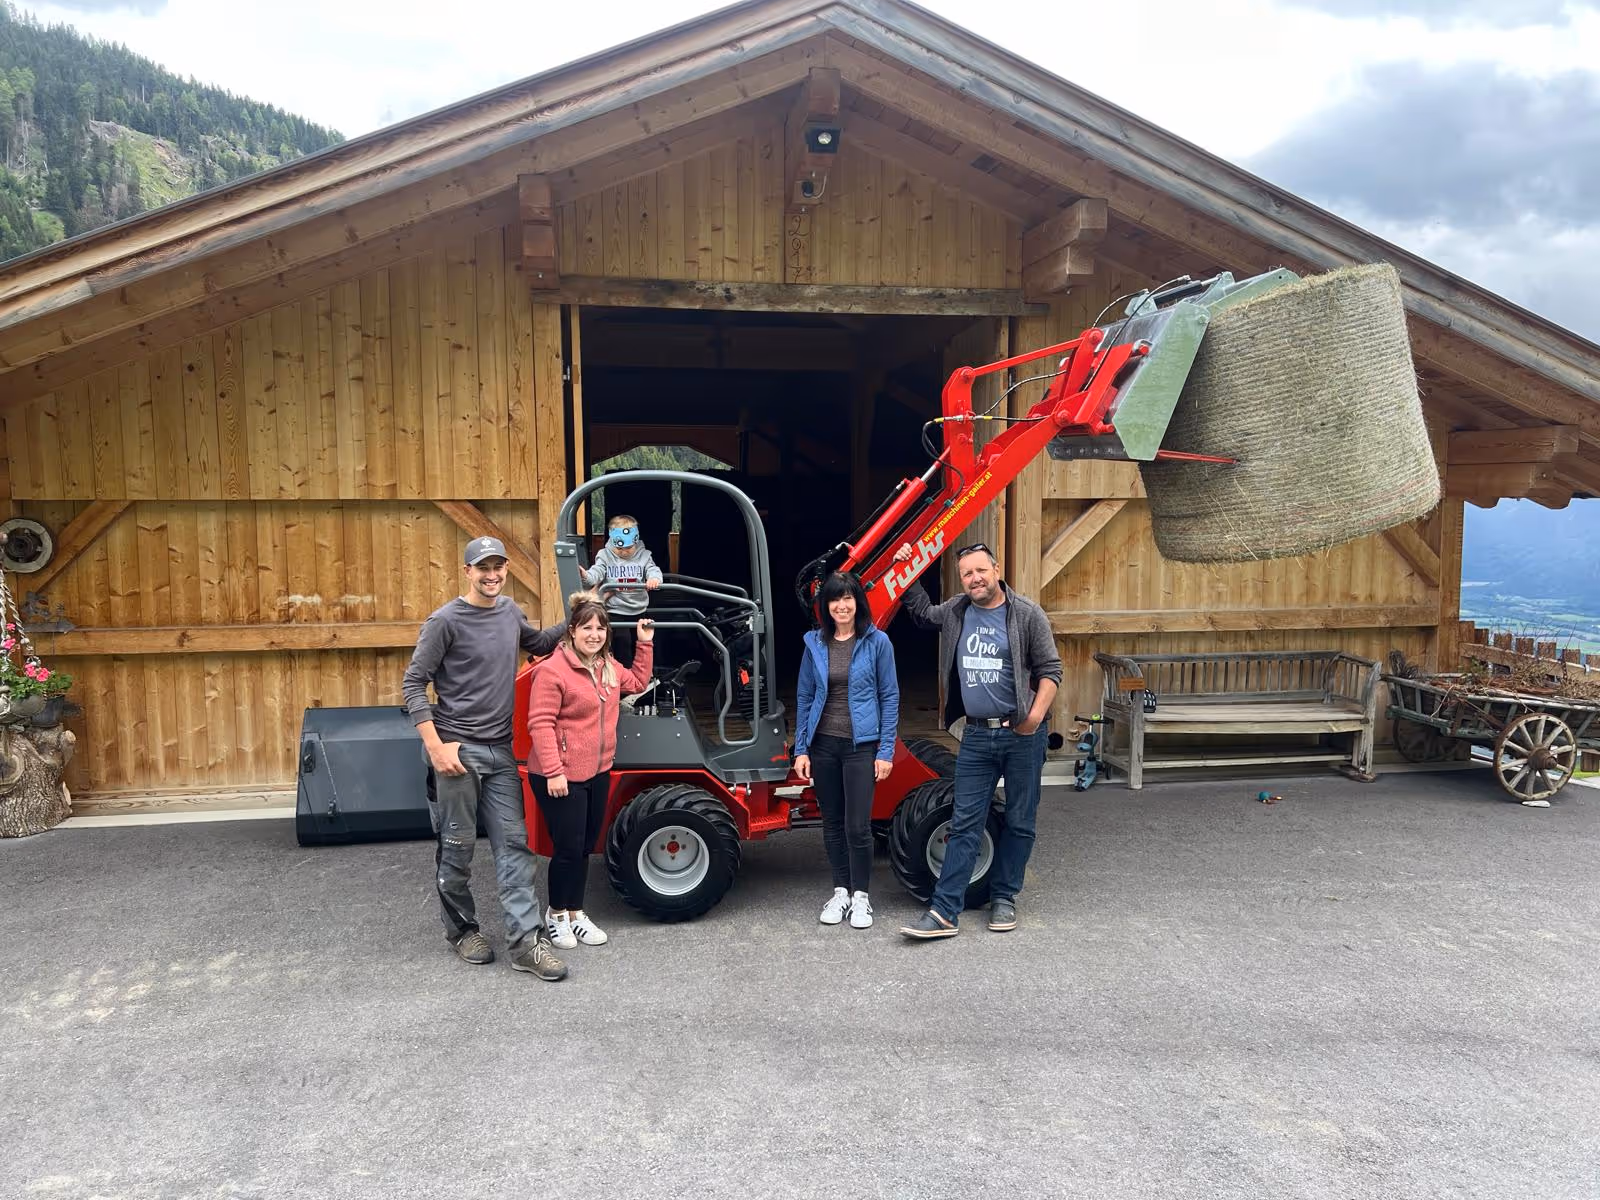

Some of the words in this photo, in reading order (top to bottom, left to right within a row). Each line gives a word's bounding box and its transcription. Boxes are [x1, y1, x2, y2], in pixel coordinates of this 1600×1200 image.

[923, 471, 993, 543] www.maschinen-gailer.at
[607, 565, 643, 578] NORWA
[883, 530, 945, 601] Fuchs
[966, 633, 999, 658] Opa
